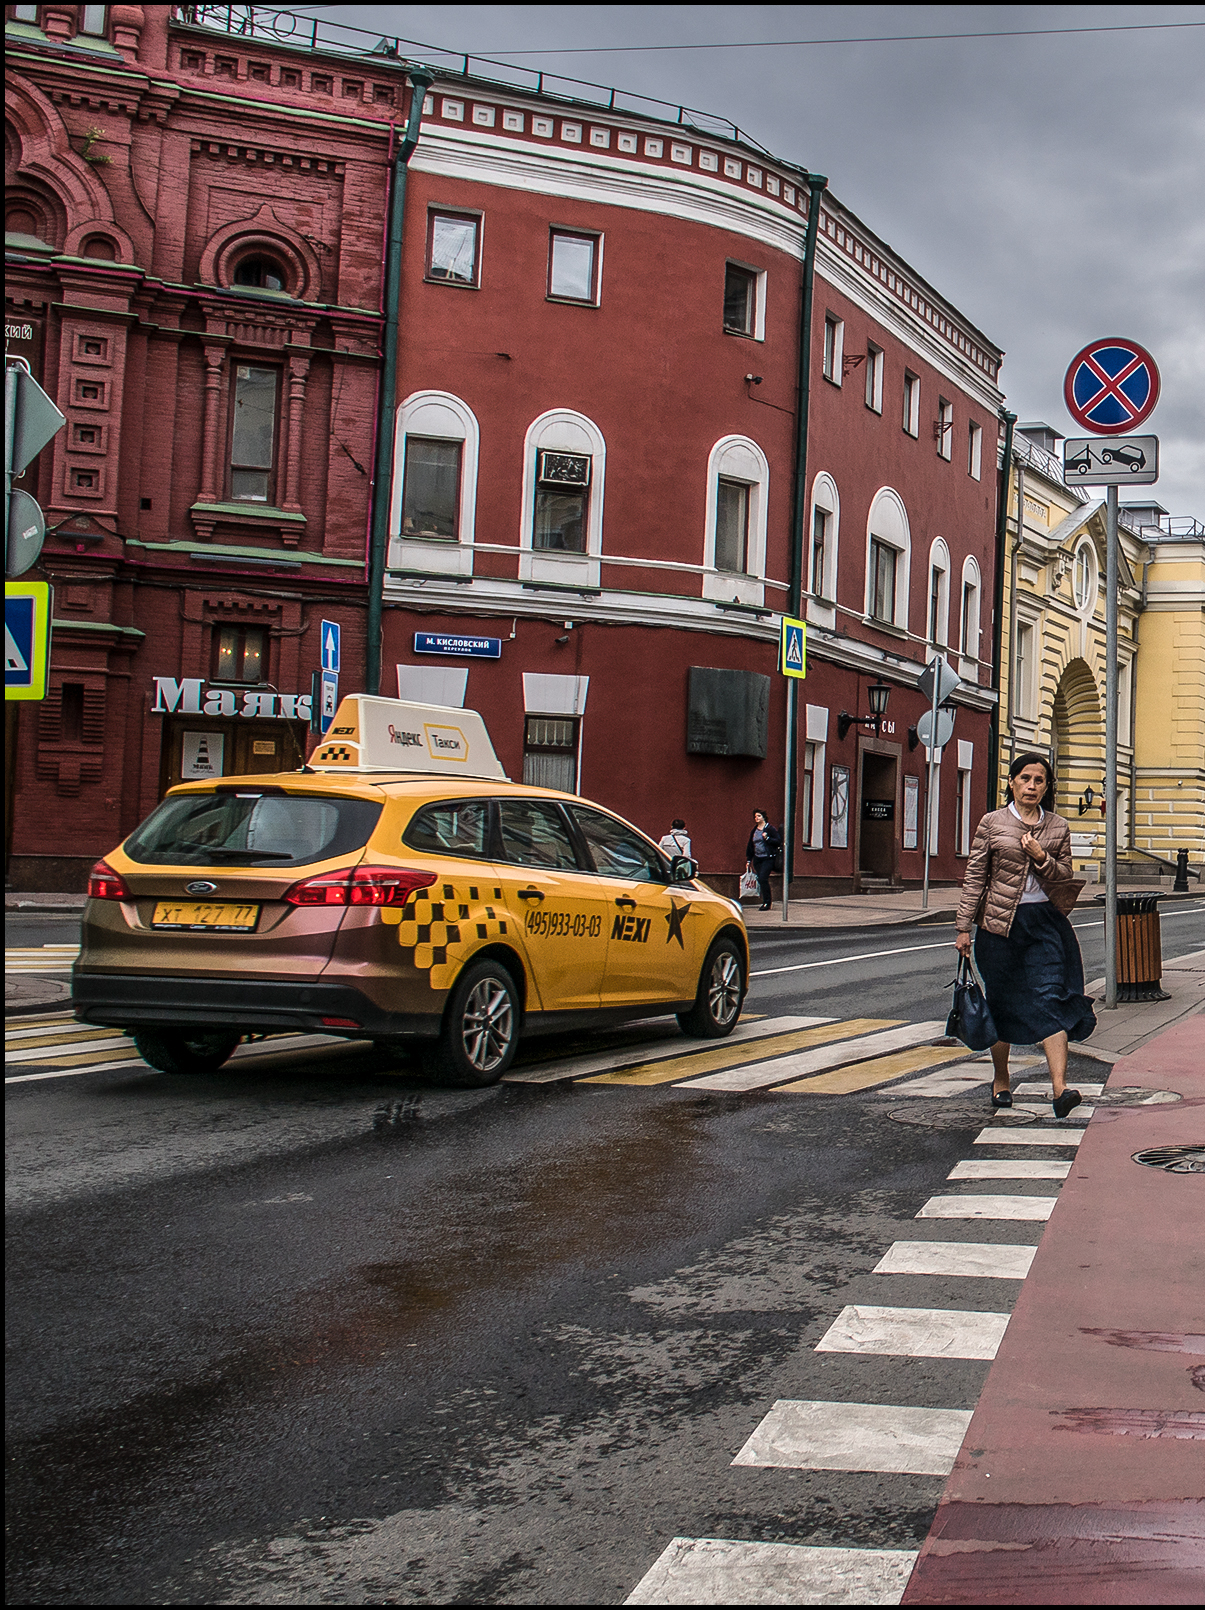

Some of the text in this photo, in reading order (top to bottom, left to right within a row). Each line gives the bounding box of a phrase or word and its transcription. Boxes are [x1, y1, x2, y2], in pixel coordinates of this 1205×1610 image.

[426, 637, 490, 649] М. КИСЛОВСКИЙ
[151, 676, 313, 721] Маяк
[387, 724, 461, 750] Яндекс Такси
[524, 910, 602, 940] (495)933-03-03
